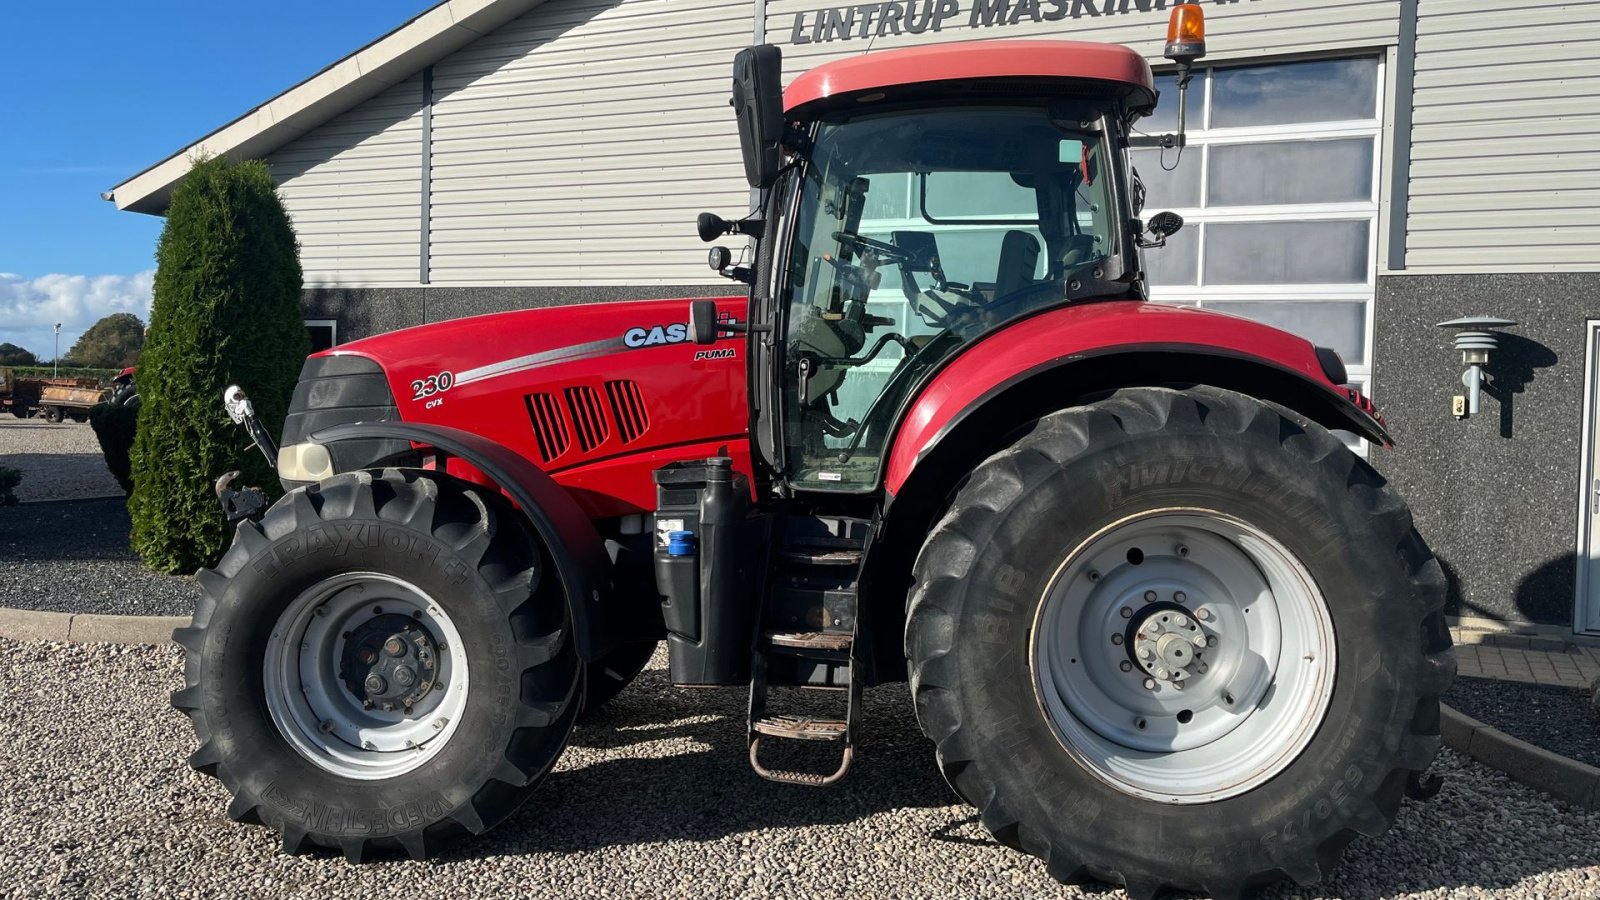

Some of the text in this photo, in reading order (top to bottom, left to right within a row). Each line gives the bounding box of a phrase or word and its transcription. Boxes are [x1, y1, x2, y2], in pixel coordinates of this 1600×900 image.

[791, 0, 959, 45] LINTRUP
[694, 348, 736, 361] PUMA
[410, 371, 452, 401] 230
[425, 397, 443, 409] CVX
[252, 523, 441, 579] TRAXION
[300, 790, 454, 835] VREDESTEIN
